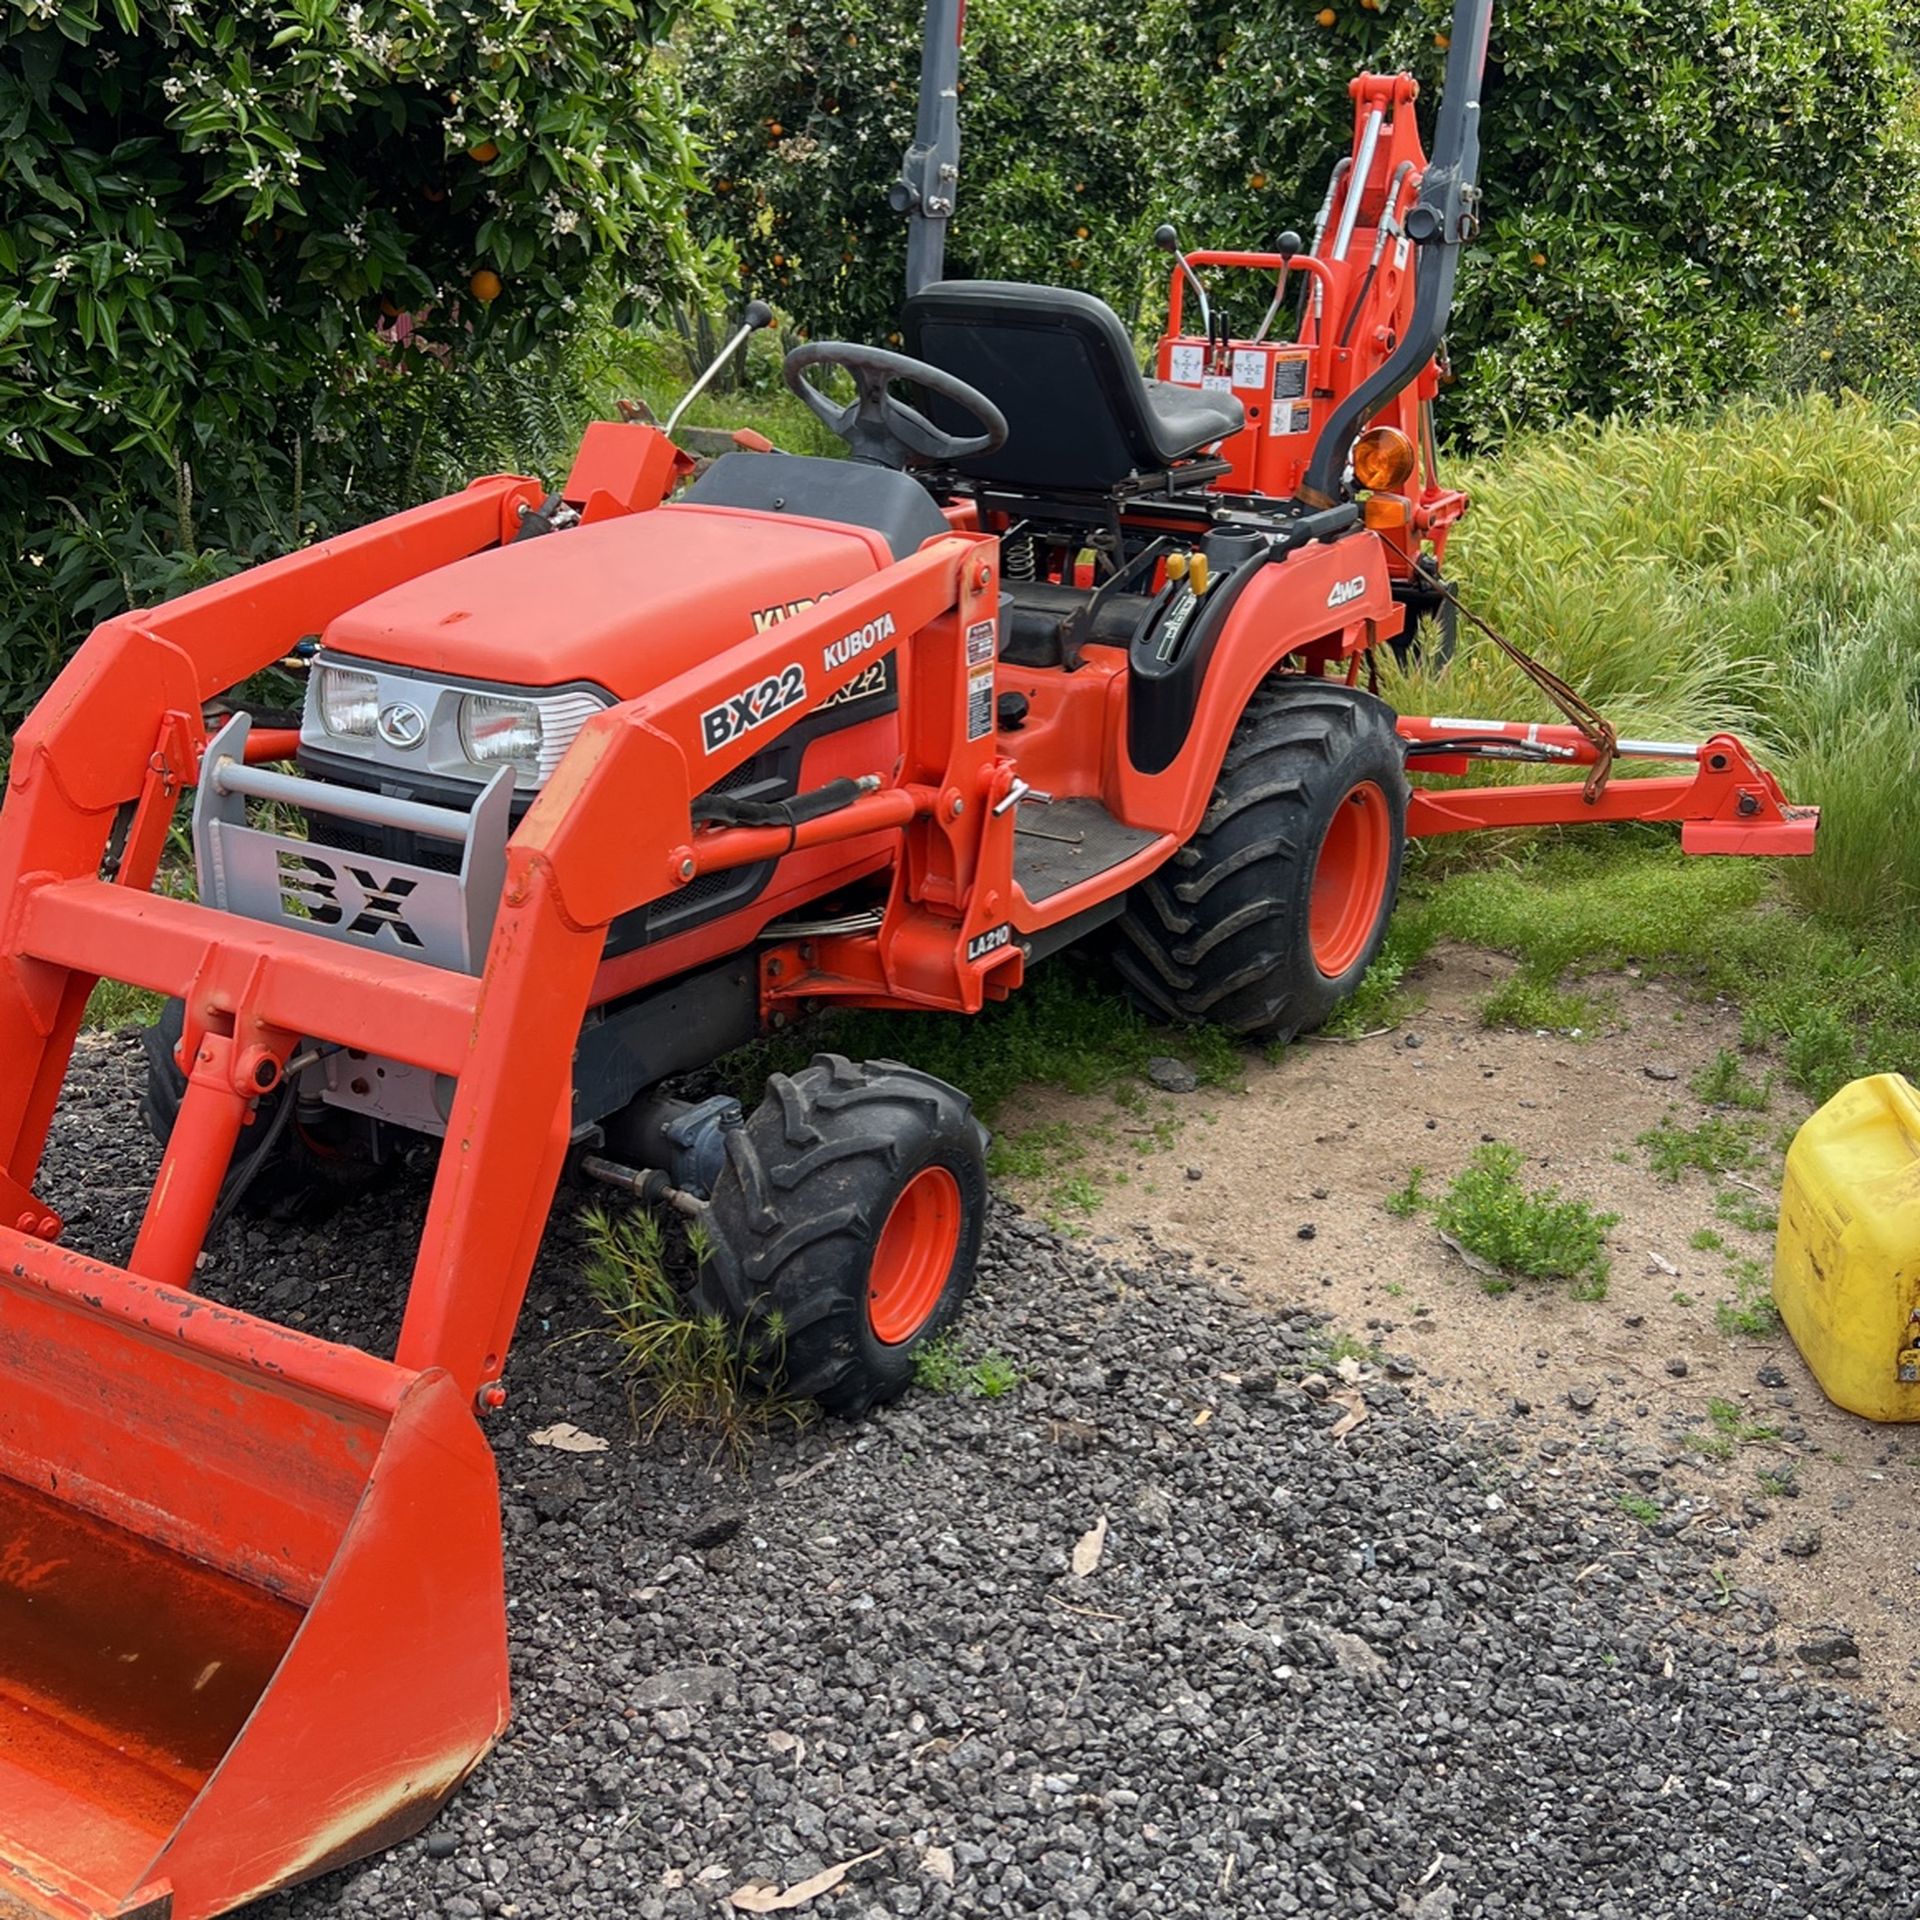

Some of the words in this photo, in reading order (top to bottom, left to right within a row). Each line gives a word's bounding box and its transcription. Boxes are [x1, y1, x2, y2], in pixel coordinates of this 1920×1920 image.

[1327, 576, 1366, 608] 4WD
[823, 613, 896, 671] KUBOTA
[701, 663, 807, 754] BX22
[277, 850, 425, 948] BX
[968, 925, 1008, 960] LA210
